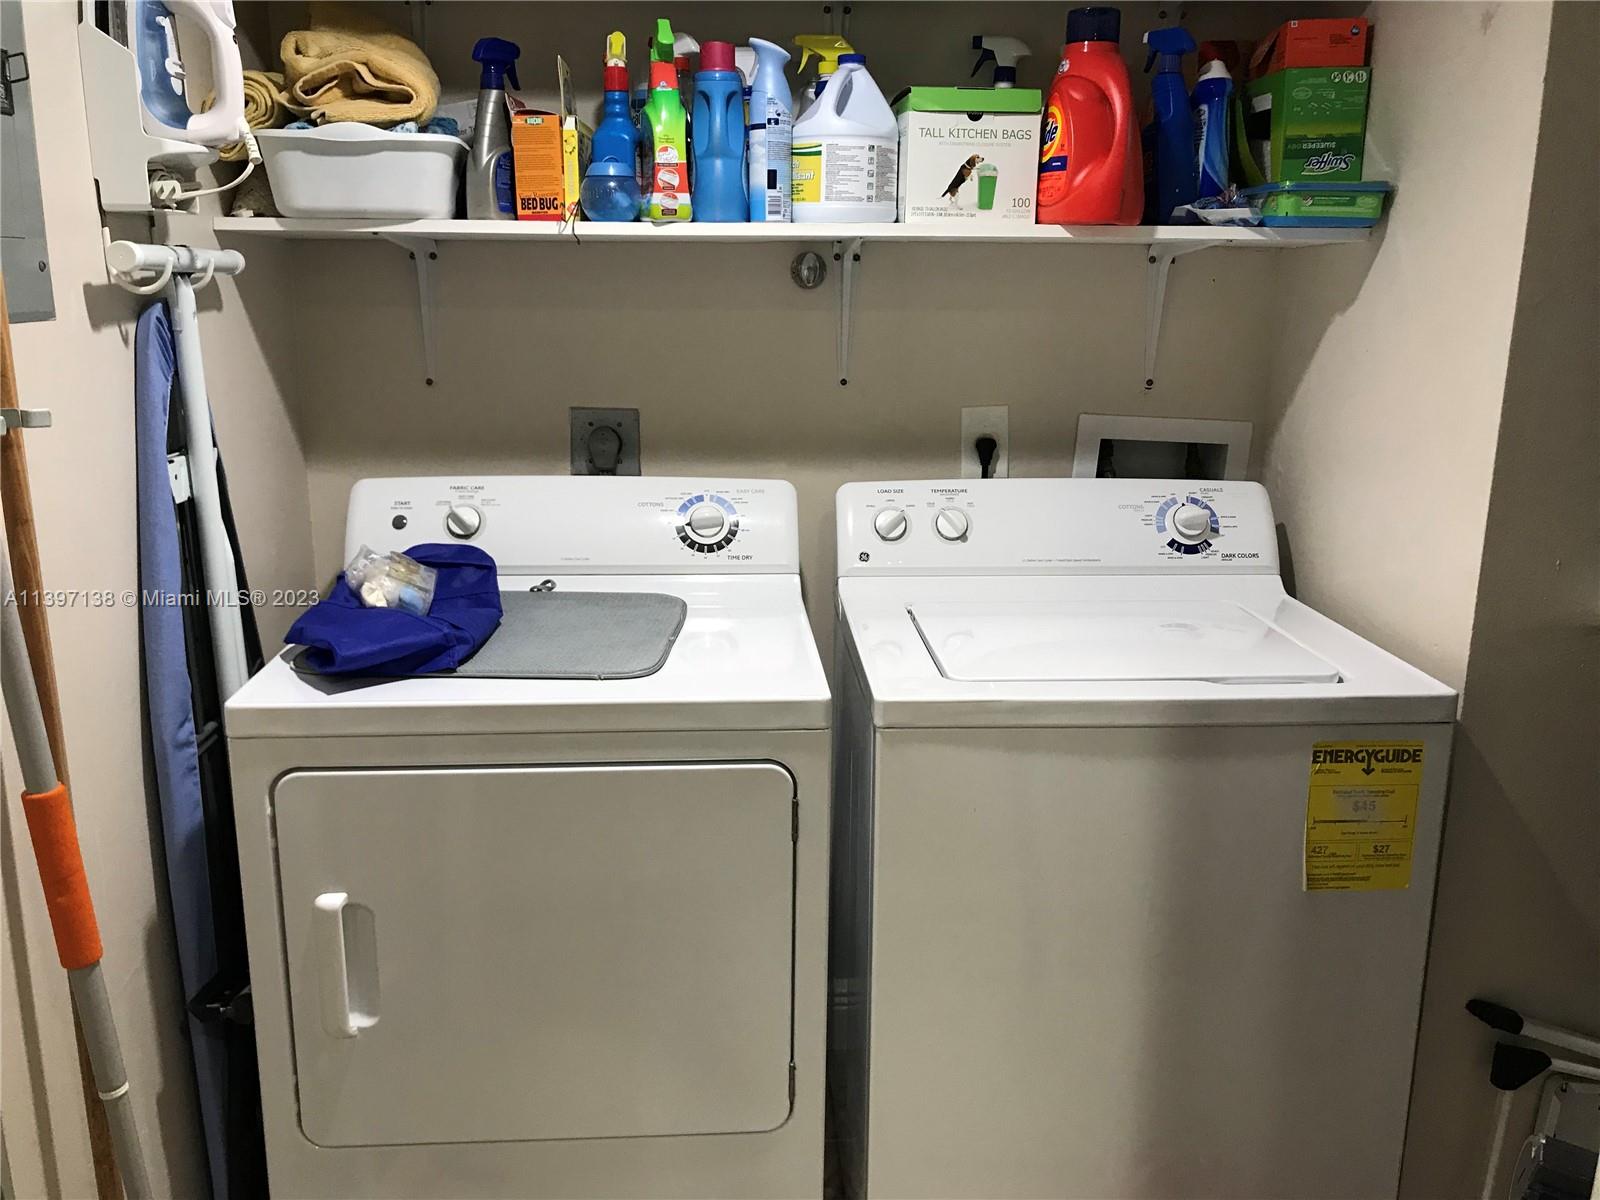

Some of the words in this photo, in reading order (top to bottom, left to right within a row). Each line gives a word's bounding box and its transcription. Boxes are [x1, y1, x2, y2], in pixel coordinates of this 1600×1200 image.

[918, 127, 945, 138] TALL
[948, 127, 998, 139] KITCHEN
[1001, 129, 1032, 140] BAGS
[1302, 141, 1336, 149] SWEEPER
[1303, 151, 1356, 171] Swiffer
[520, 198, 538, 210] BED
[540, 197, 559, 210] BUG
[1012, 198, 1031, 208] 100
[1311, 748, 1424, 764] ENERGYGUIDE
[1352, 800, 1377, 813] $45
[1311, 845, 1329, 855] 427
[1372, 844, 1391, 854] $27
